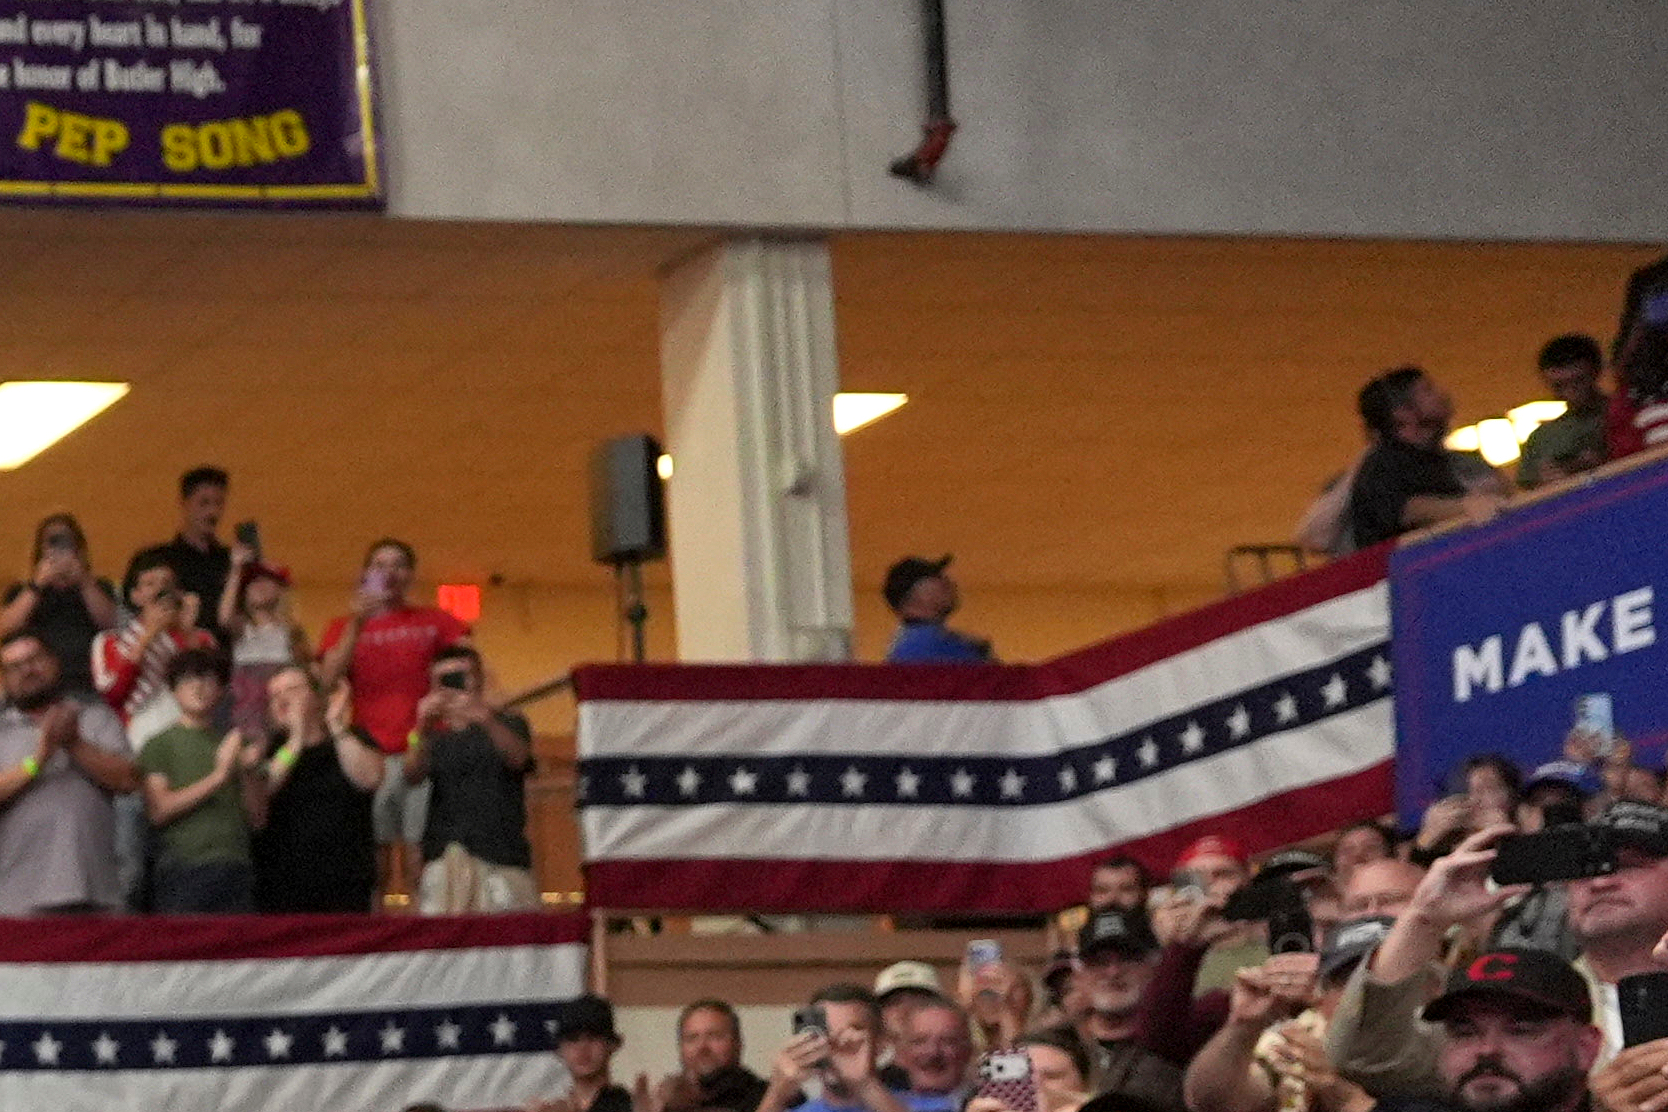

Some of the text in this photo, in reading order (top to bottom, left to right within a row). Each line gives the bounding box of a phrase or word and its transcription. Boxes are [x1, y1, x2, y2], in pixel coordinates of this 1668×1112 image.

[31, 19, 84, 51] every
[88, 13, 141, 46] heart
[231, 16, 263, 48] for
[13, 56, 72, 90] honor
[75, 57, 100, 91] of
[17, 101, 311, 172] PEP SONG
[1452, 585, 1657, 702] MAKE
[1466, 952, 1520, 982] C
